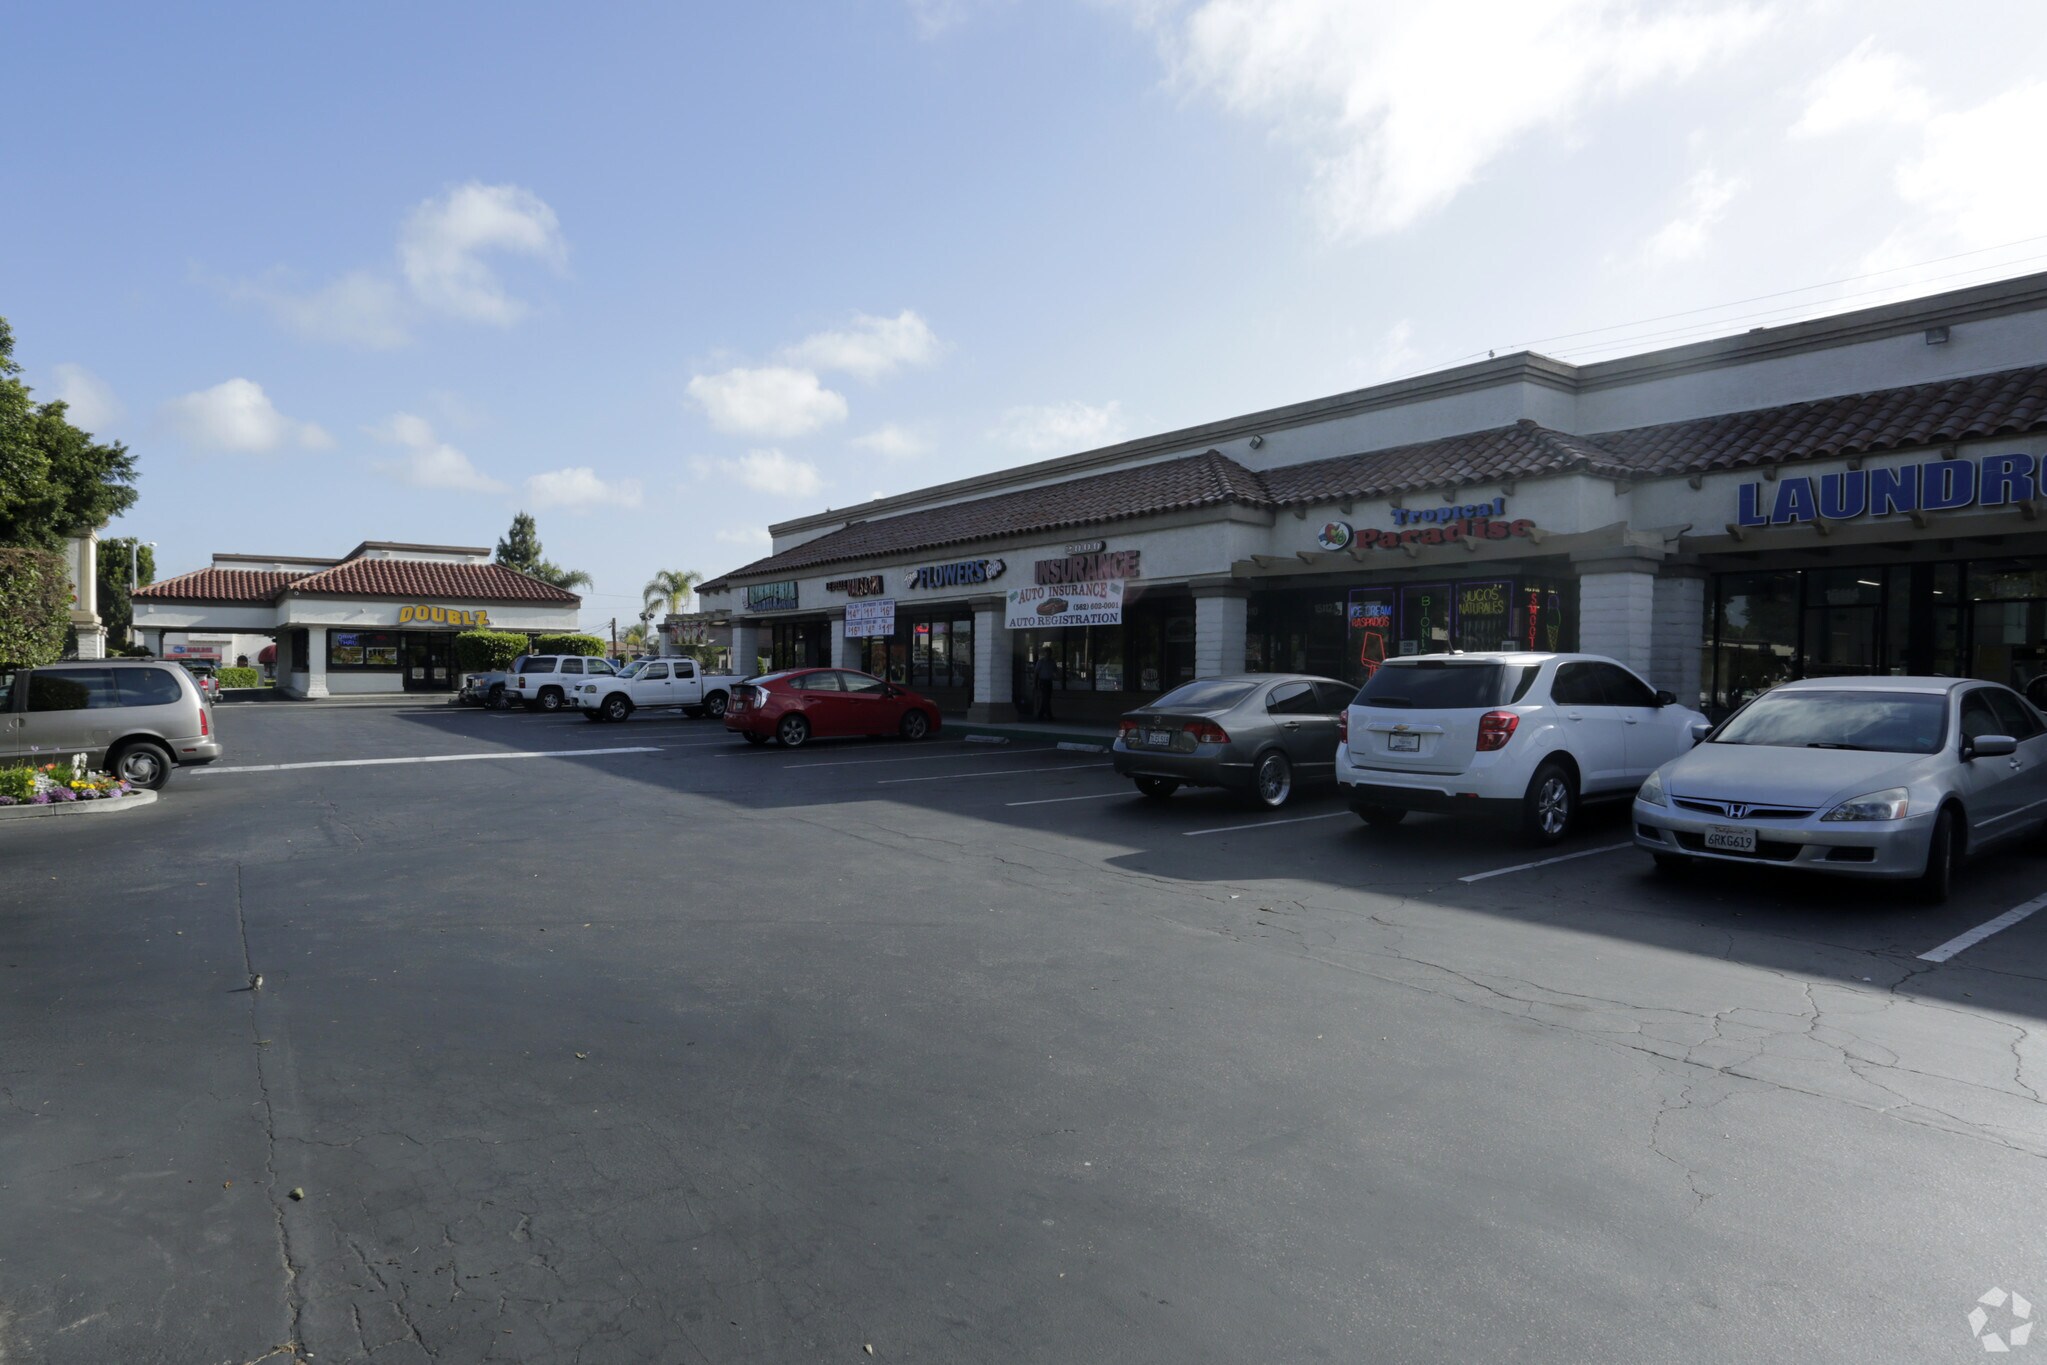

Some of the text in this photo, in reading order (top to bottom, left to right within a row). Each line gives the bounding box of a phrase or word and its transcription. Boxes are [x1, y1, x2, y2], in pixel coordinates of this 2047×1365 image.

[1738, 453, 2047, 526] LAUNDR
[1391, 498, 1505, 525] Tropical
[1354, 518, 1536, 549] Paradise
[1065, 541, 1105, 555] 2000
[919, 560, 985, 589] FLOWERS
[1035, 550, 1140, 585] INSURANCE
[1018, 582, 1108, 604] AUTO INSURANCE
[1464, 588, 1500, 602] JUGOS
[1073, 602, 1119, 611] (562) 602-0001
[1350, 605, 1392, 618] ICE CREAM
[1459, 600, 1504, 615] NATURALES
[399, 605, 490, 626] DOUBLZ
[1009, 612, 1119, 628] AUTO REGISTRATION
[1352, 616, 1390, 628] RASPADOS
[1708, 833, 1753, 849] 6RKG619
